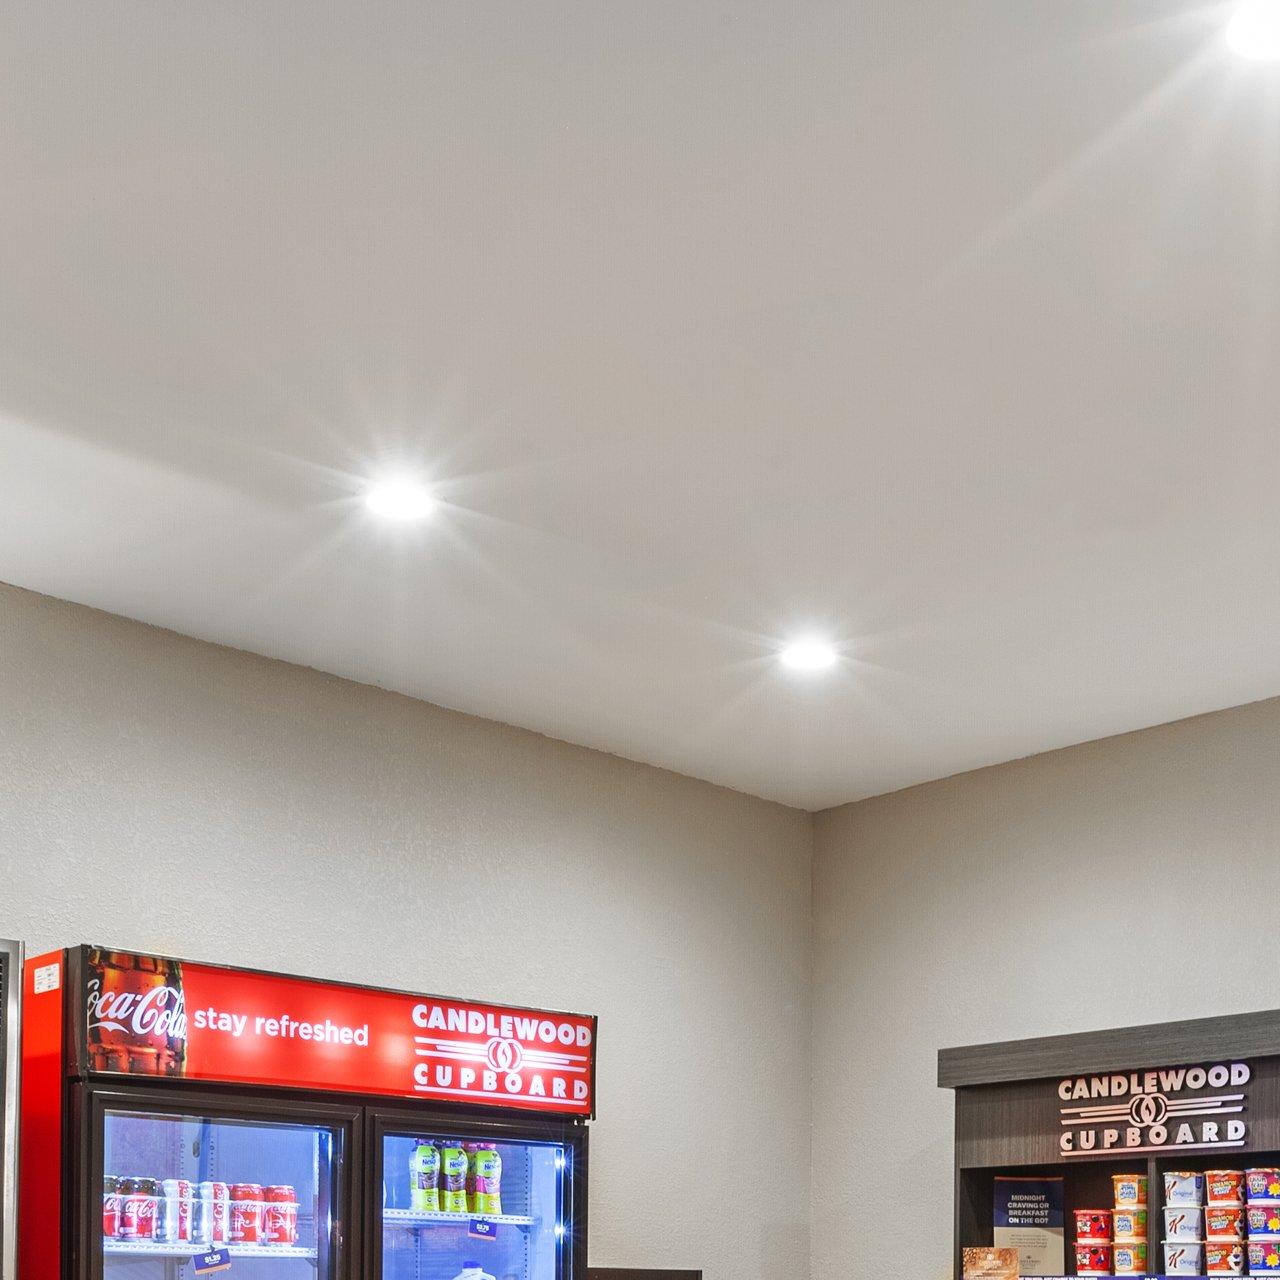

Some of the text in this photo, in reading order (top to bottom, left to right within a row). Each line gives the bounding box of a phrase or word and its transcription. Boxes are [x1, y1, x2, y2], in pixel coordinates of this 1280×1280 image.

[194, 1008, 369, 1047] stay refreshed
[412, 1003, 592, 1048] CANDLEWOOD
[414, 1063, 588, 1100] CUPBOARD
[1058, 1063, 1250, 1101] CANDLEWOOD
[1059, 1119, 1246, 1152] CUPBOARD
